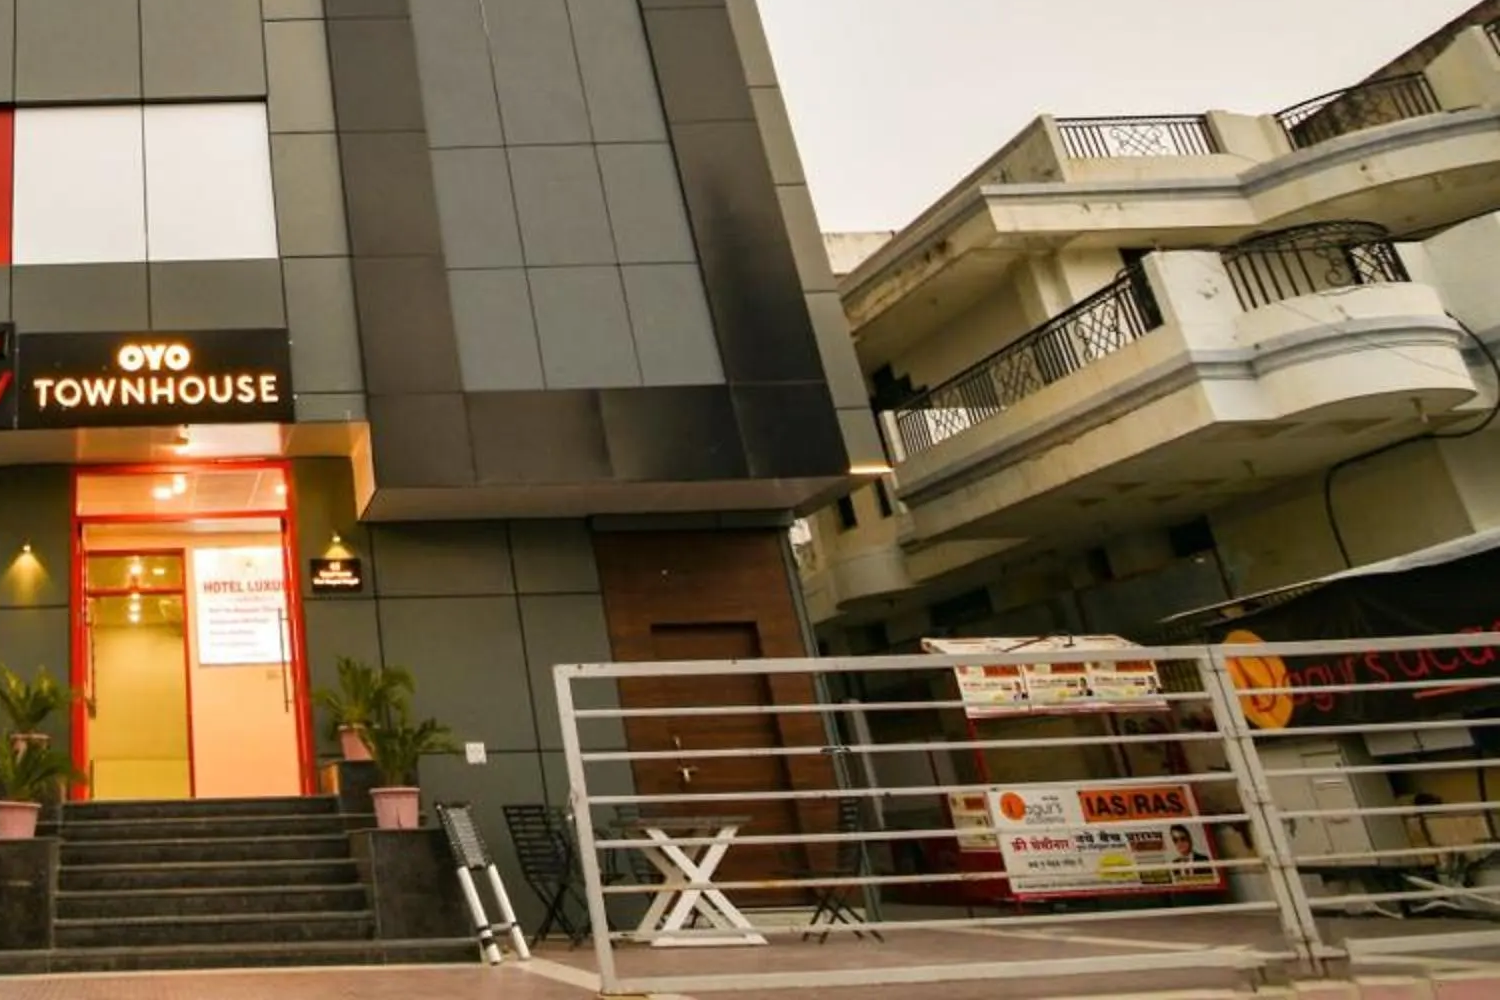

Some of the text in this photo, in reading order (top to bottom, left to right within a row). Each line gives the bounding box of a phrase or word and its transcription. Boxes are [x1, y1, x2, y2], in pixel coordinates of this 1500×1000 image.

[118, 343, 191, 372] OYO
[32, 374, 280, 408] TOWNHOUSE
[203, 579, 244, 594] HOTEL
